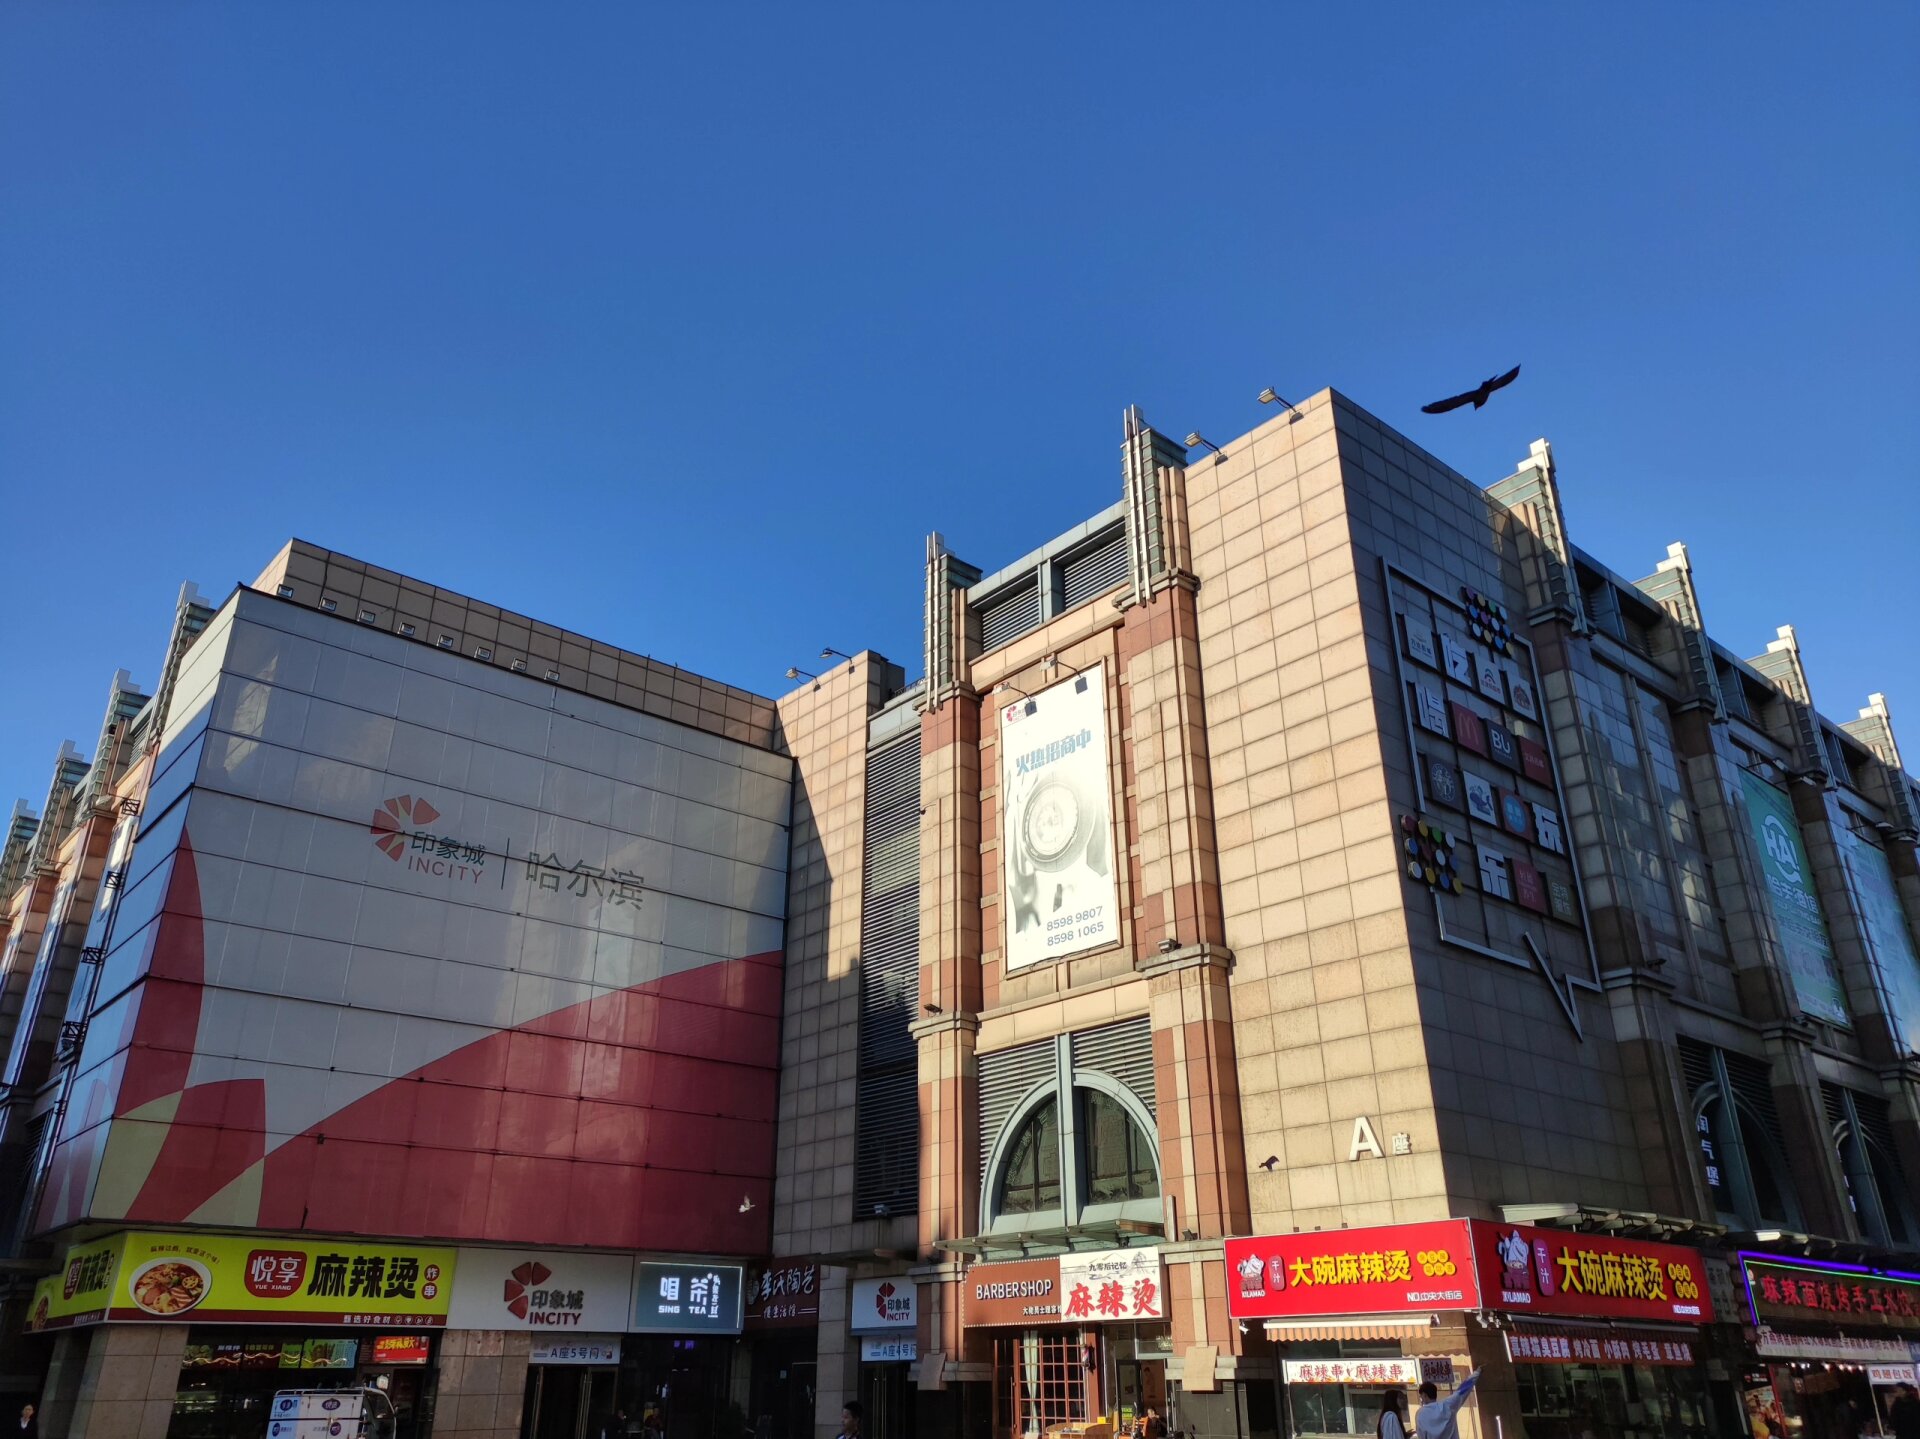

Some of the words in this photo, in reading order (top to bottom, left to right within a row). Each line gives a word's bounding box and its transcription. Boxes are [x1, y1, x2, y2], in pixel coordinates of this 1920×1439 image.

[1016, 728, 1092, 776] 火热招商中
[411, 831, 486, 867] 印象城
[408, 855, 484, 885] INCITY
[525, 851, 646, 911] 哈尔滨
[1047, 914, 1074, 931] 8598
[1076, 906, 1104, 925] 9807
[1047, 930, 1075, 946] 8598
[1077, 921, 1105, 941] 1065
[251, 1255, 302, 1283] 悦享
[307, 1253, 419, 1299] 麻辣烫
[1089, 1261, 1127, 1272] 九零后记忆
[1289, 1249, 1412, 1288] 大碗麻辣烫
[1557, 1246, 1668, 1301] 大碗麻辣烫
[423, 1266, 438, 1298] 炸串
[761, 1264, 815, 1301] 李氏陶艺
[976, 1279, 1053, 1300] BARBERSHOP
[1761, 1274, 1920, 1318] 麻辣面烧烤手工水饺
[530, 1289, 584, 1310] 印象城
[658, 1305, 680, 1314] SING
[688, 1306, 707, 1315] TEA
[887, 1298, 910, 1311] 印象城
[1065, 1277, 1160, 1318] 麻辣烫
[529, 1312, 582, 1325] INCITY
[887, 1312, 910, 1321] INCITY
[551, 1347, 600, 1360] A座5号门
[1299, 1364, 1345, 1379] 麻辣串
[1355, 1363, 1403, 1379] 麻辣串
